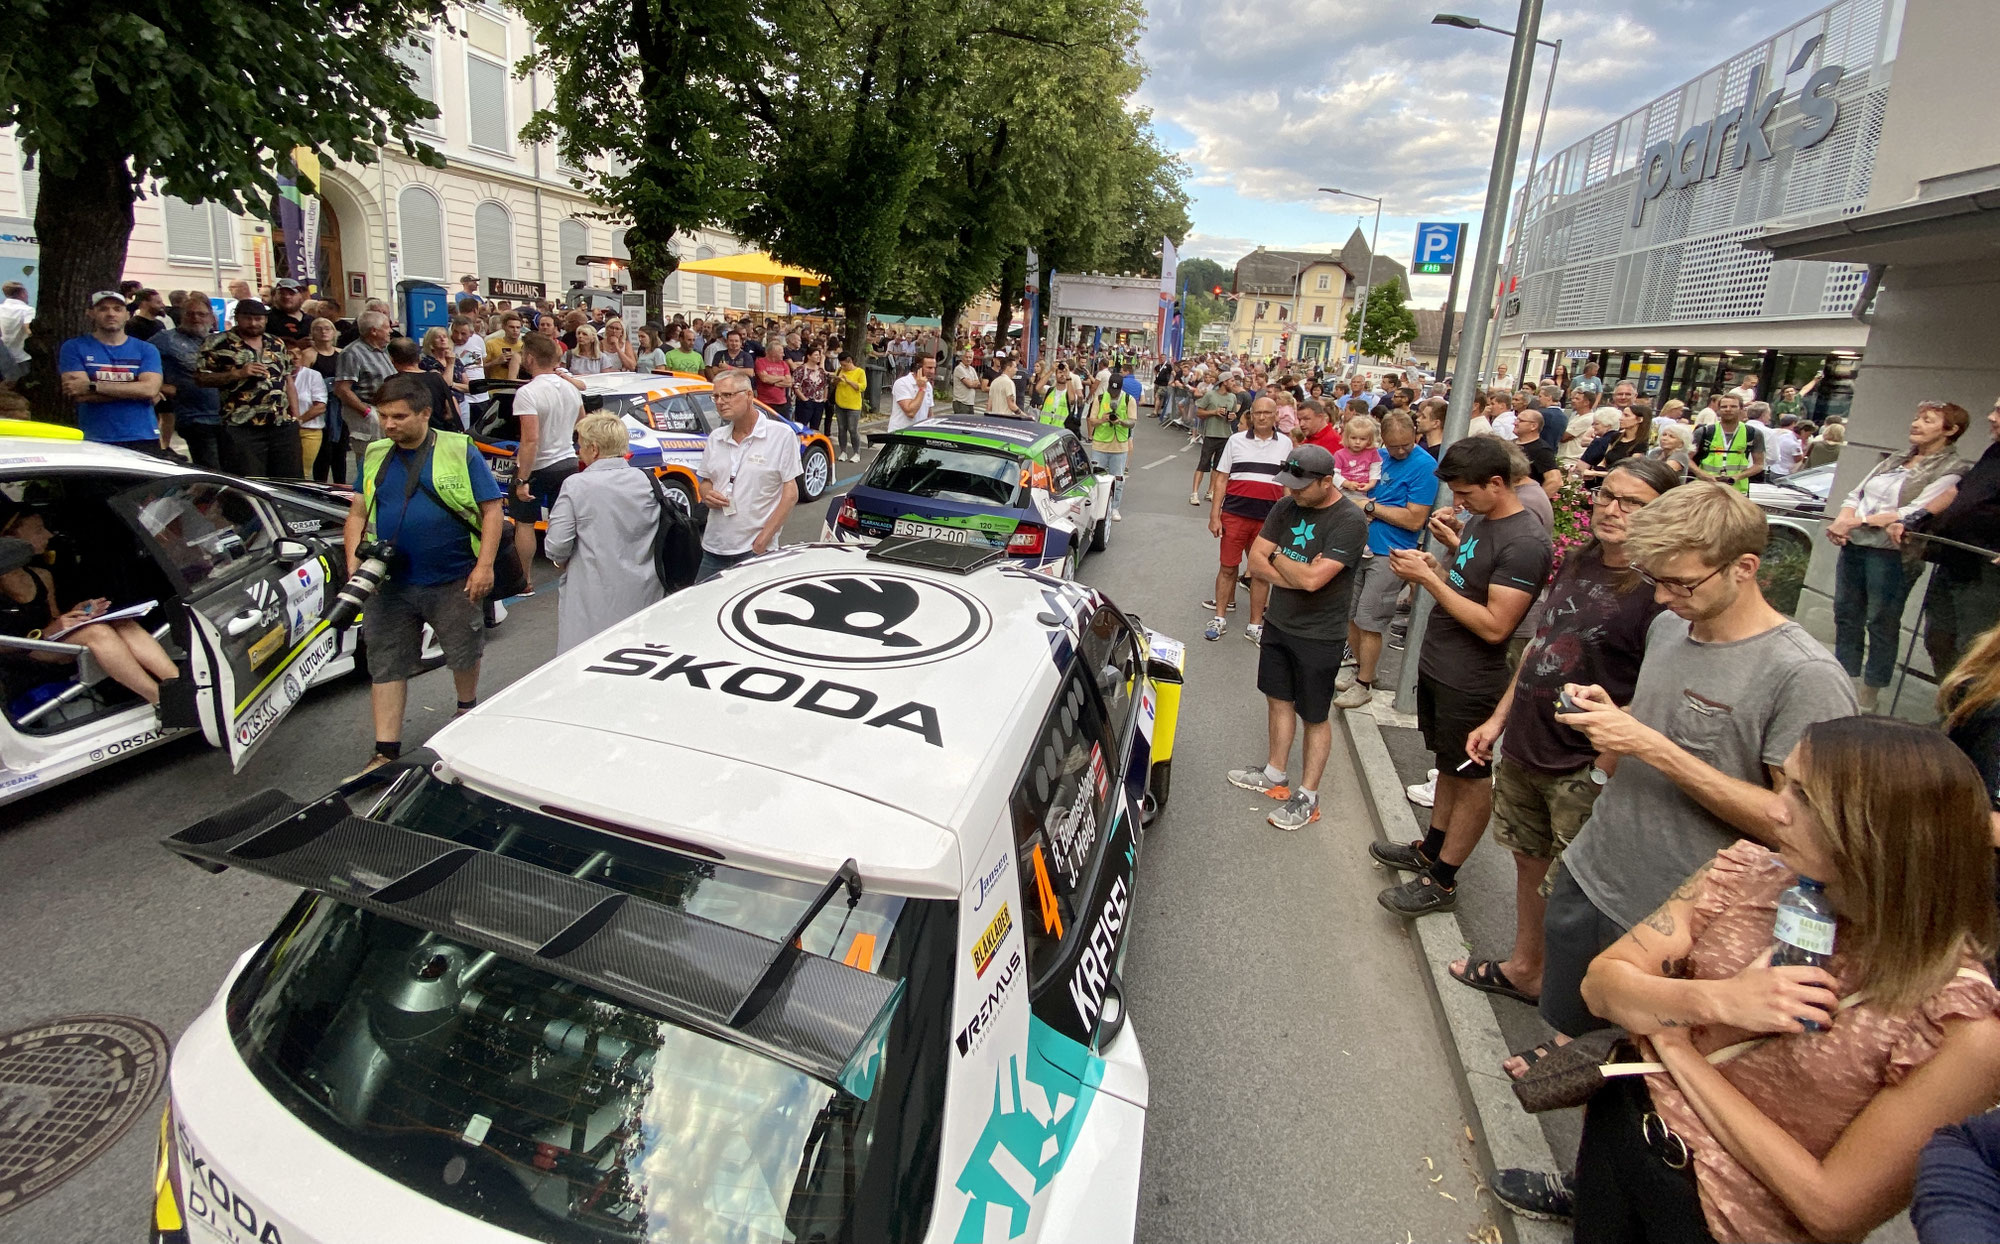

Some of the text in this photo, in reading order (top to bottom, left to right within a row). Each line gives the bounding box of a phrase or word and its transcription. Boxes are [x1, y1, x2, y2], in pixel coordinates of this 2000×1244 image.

[502, 280, 539, 298] TOLLHAUS
[438, 483, 465, 491] MEDIA
[906, 523, 924, 537] SP
[298, 636, 334, 680] AUTOKLUB
[235, 696, 279, 746] ORSAK
[584, 643, 944, 748] ŠKODA
[1074, 804, 1097, 868] Heigl
[972, 852, 1008, 912] Jansen
[1033, 842, 1063, 941] 4
[968, 951, 1021, 1045] REMUS
[972, 994, 1010, 1056] PERFORMANCE
